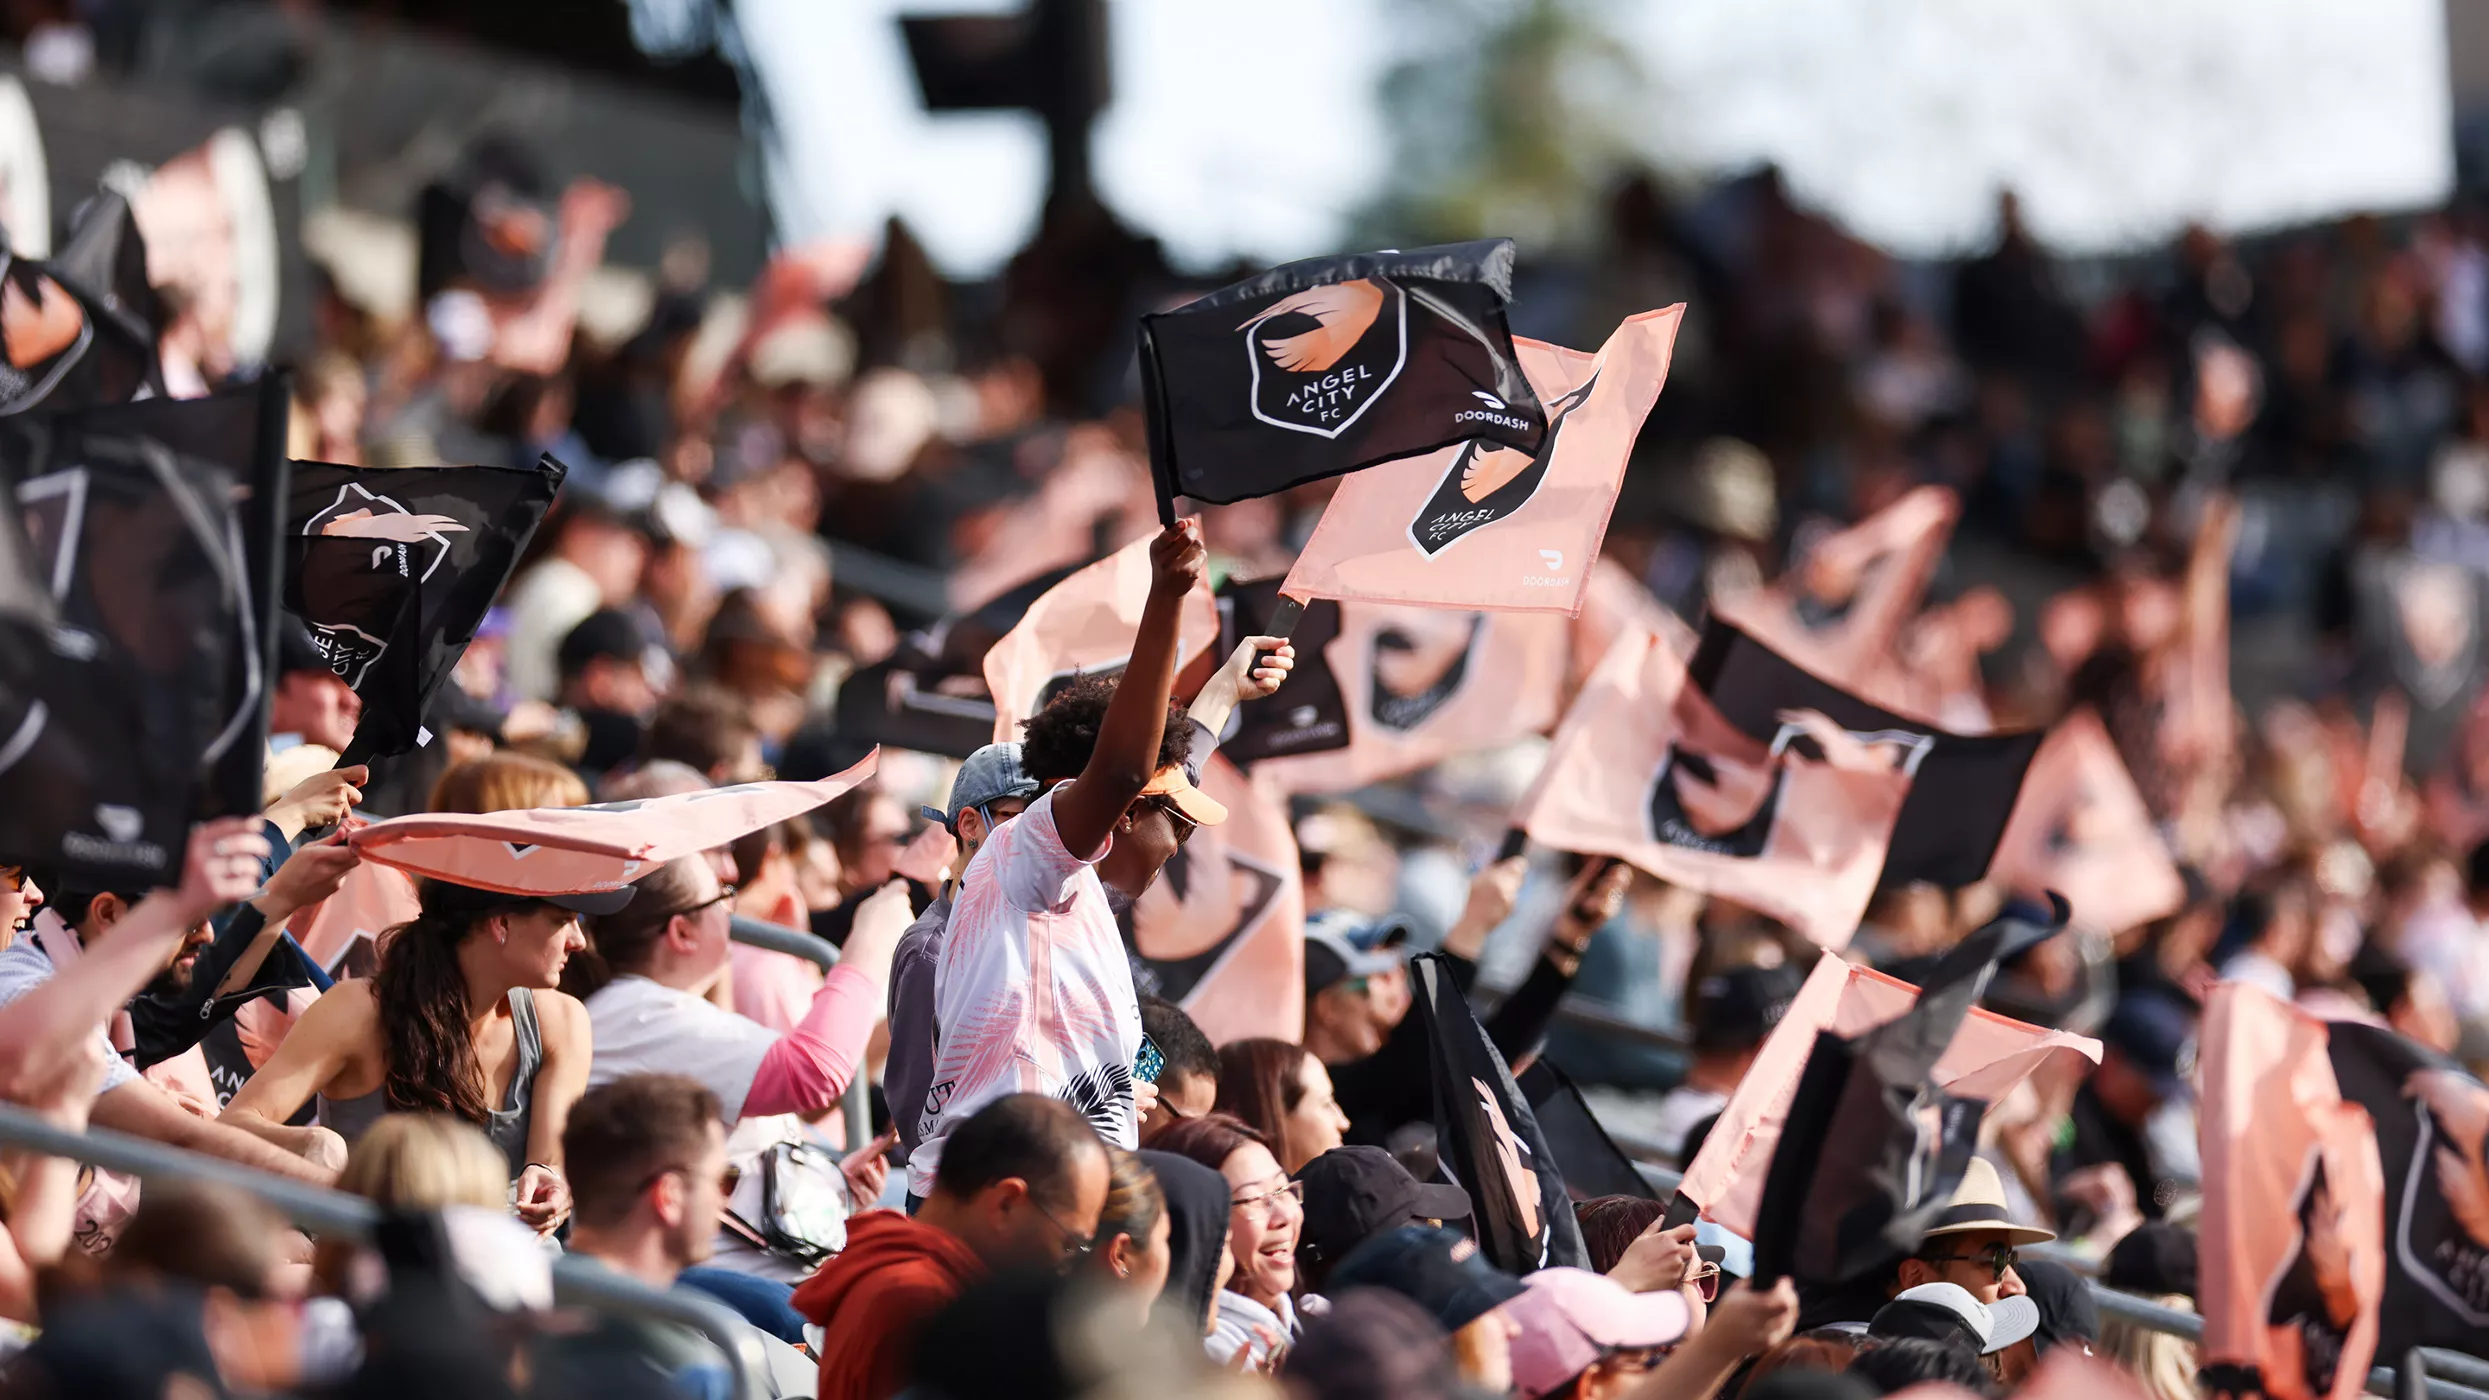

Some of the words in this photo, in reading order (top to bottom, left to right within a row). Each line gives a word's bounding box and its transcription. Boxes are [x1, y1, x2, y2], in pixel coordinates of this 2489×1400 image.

[1286, 364, 1372, 407] ANGEL
[1301, 384, 1356, 413] CITY
[1320, 407, 1341, 422] FC
[1454, 410, 1530, 432] DOORDASH
[1430, 508, 1496, 524] ANGEL
[1428, 521, 1474, 532] CITY
[1428, 531, 1447, 541] FC
[331, 643, 355, 676] CITY
